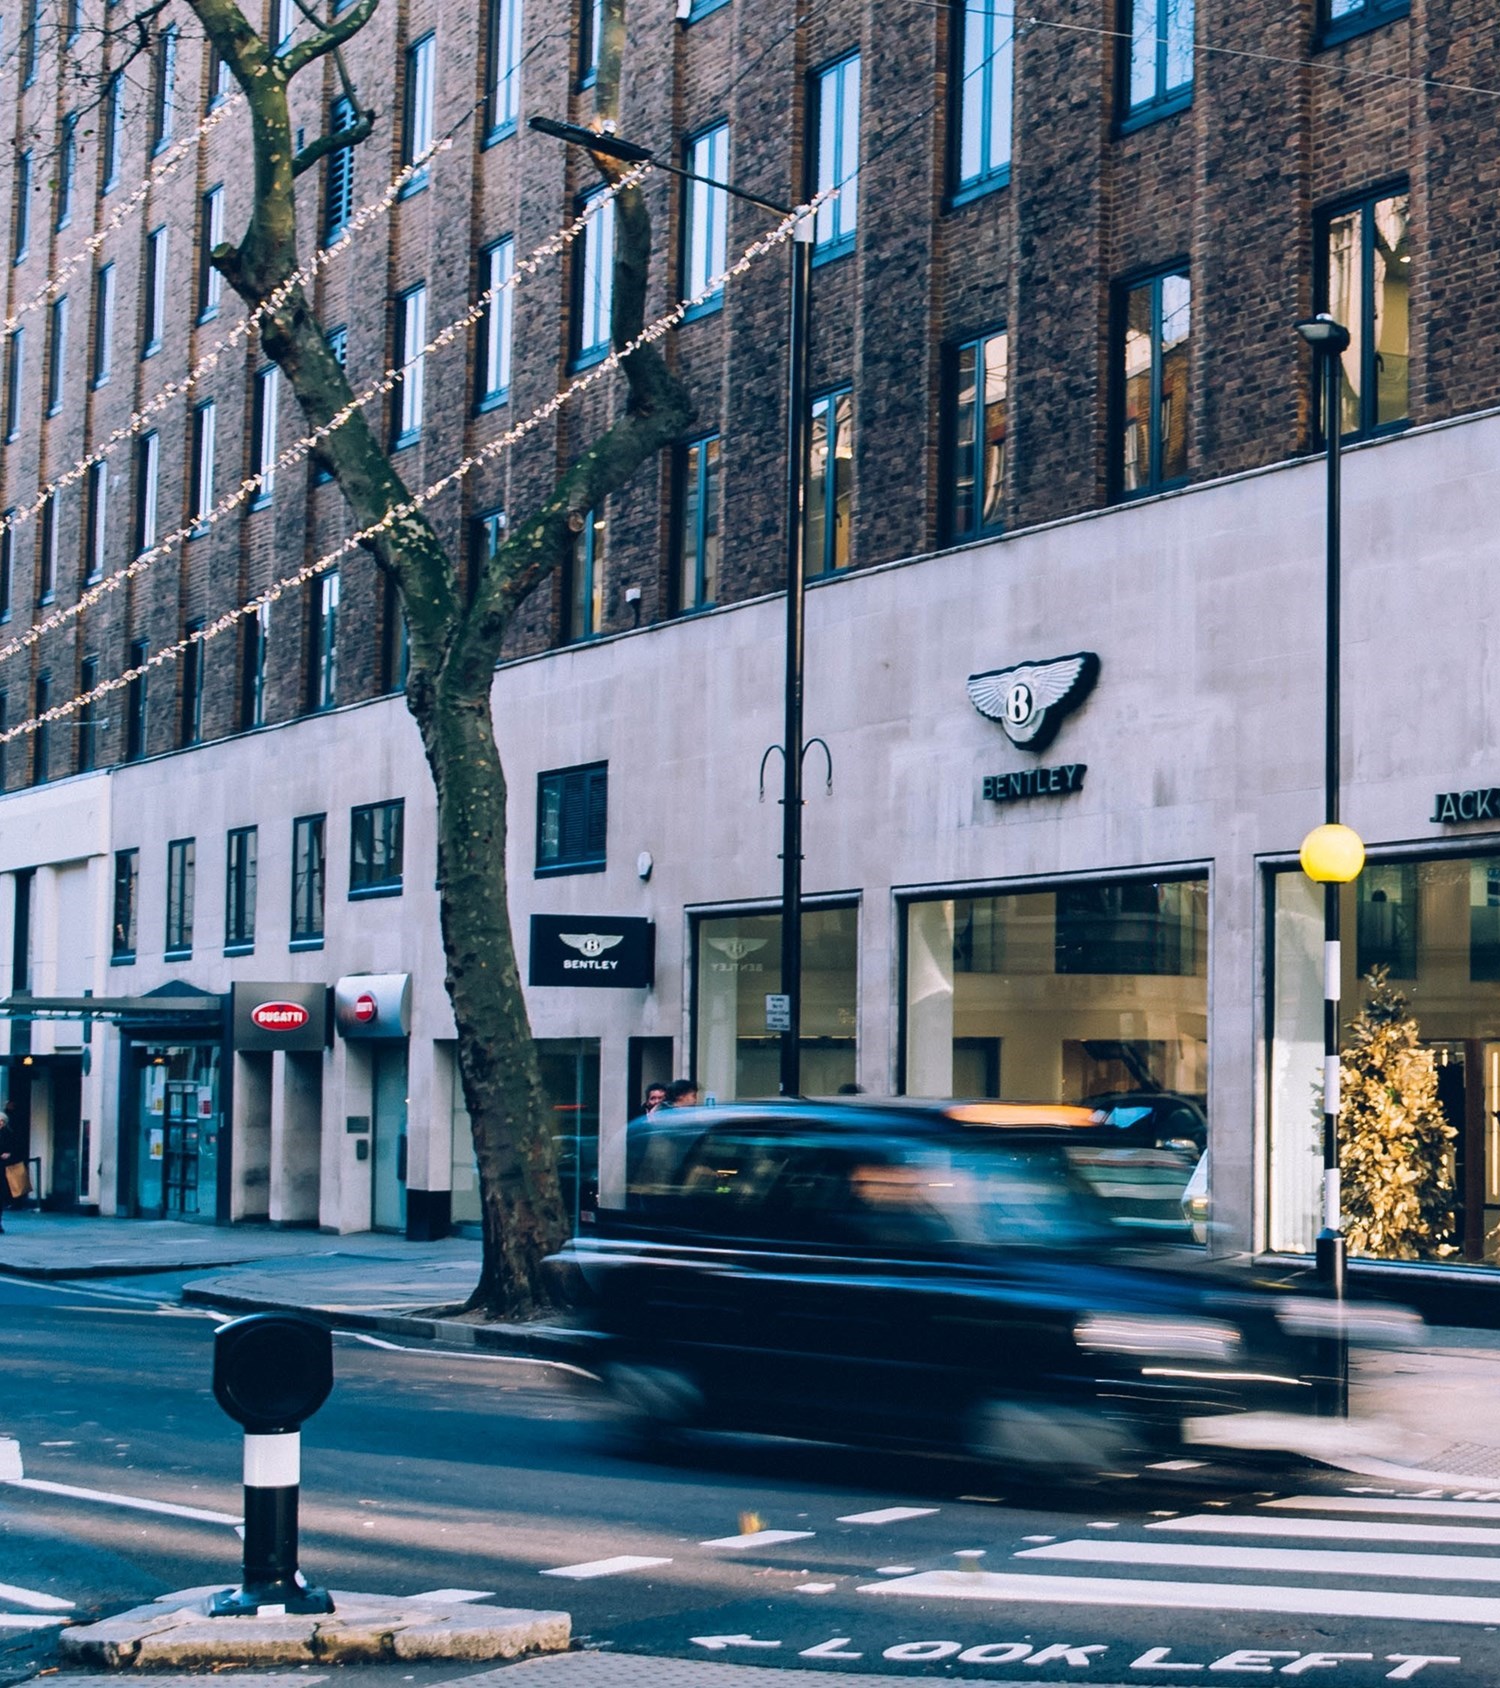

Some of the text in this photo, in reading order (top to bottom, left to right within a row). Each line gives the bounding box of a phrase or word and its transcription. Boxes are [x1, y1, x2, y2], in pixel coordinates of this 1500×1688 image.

[983, 764, 1082, 801] BENTLEY
[1430, 787, 1494, 823] JACK
[563, 959, 618, 970] BENTLEY
[257, 1011, 303, 1023] BUGATTI
[798, 1638, 1461, 1679] LOOK LEFT
